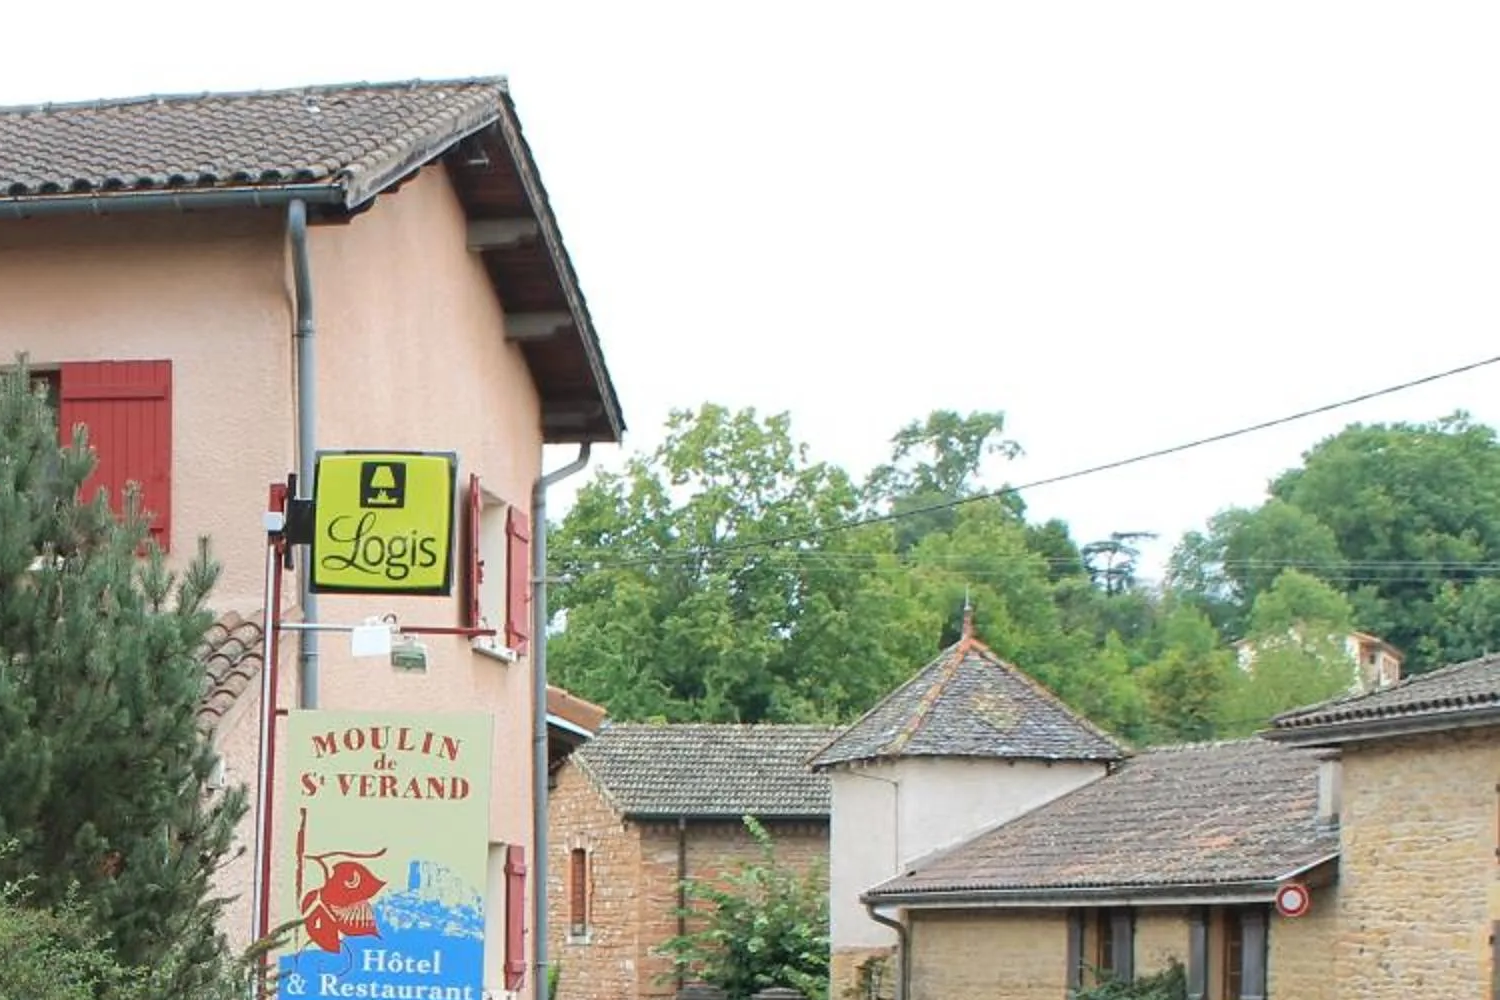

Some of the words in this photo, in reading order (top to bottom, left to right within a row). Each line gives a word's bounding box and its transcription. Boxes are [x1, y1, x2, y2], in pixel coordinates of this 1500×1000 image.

[321, 511, 437, 581] Logis
[311, 725, 461, 761] MOULIN
[373, 753, 398, 771] de
[337, 772, 469, 800] VERAND
[362, 949, 441, 975] Hôtel
[286, 974, 306, 996] &
